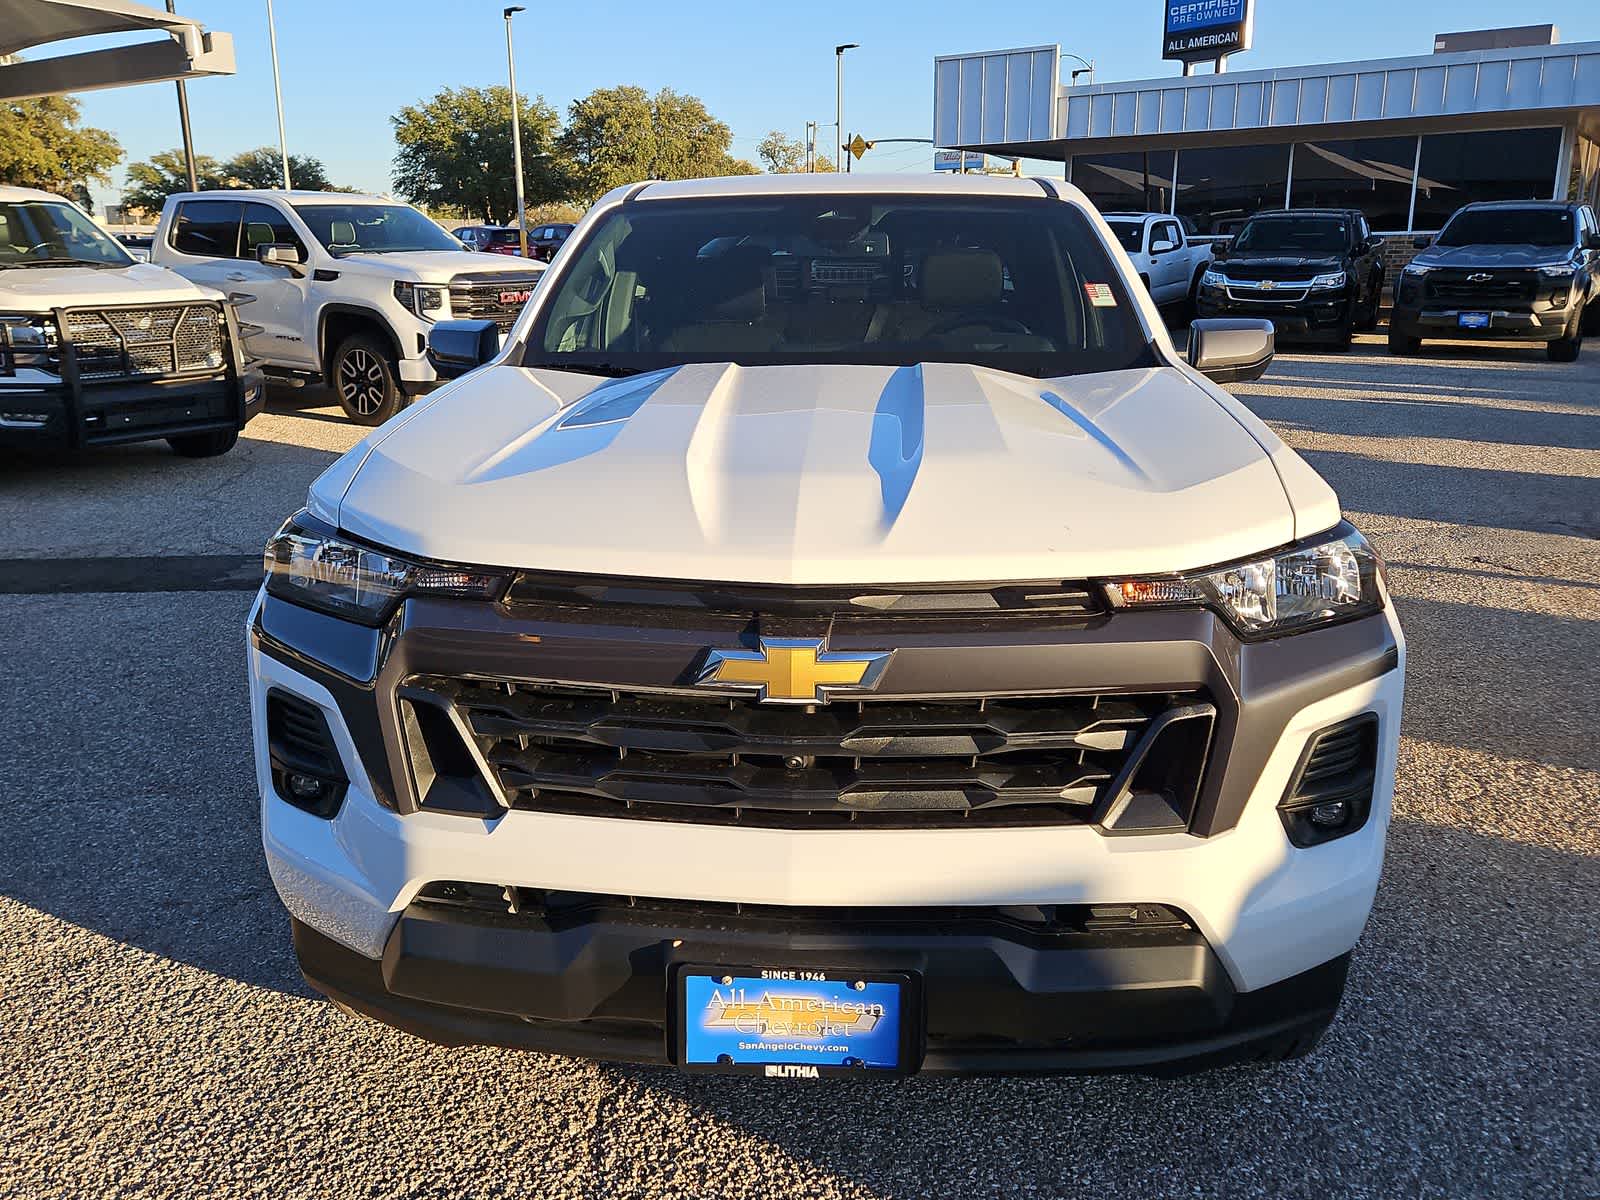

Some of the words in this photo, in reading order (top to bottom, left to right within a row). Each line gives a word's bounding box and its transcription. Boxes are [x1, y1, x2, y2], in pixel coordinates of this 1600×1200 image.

[1170, 0, 1240, 16] CERTIFIED
[1173, 7, 1236, 24] PRE-OWNED
[1168, 41, 1186, 51] ALL
[1188, 32, 1239, 48] AMERICAN
[500, 291, 533, 303] GM
[761, 970, 796, 981] SINCE
[799, 972, 826, 982] 1946
[704, 988, 746, 1010] All
[755, 991, 886, 1017] American
[734, 1012, 853, 1039] Chevrolet
[738, 1041, 849, 1053] SanAngeloChevy.com
[777, 1065, 820, 1079] LITHIA
